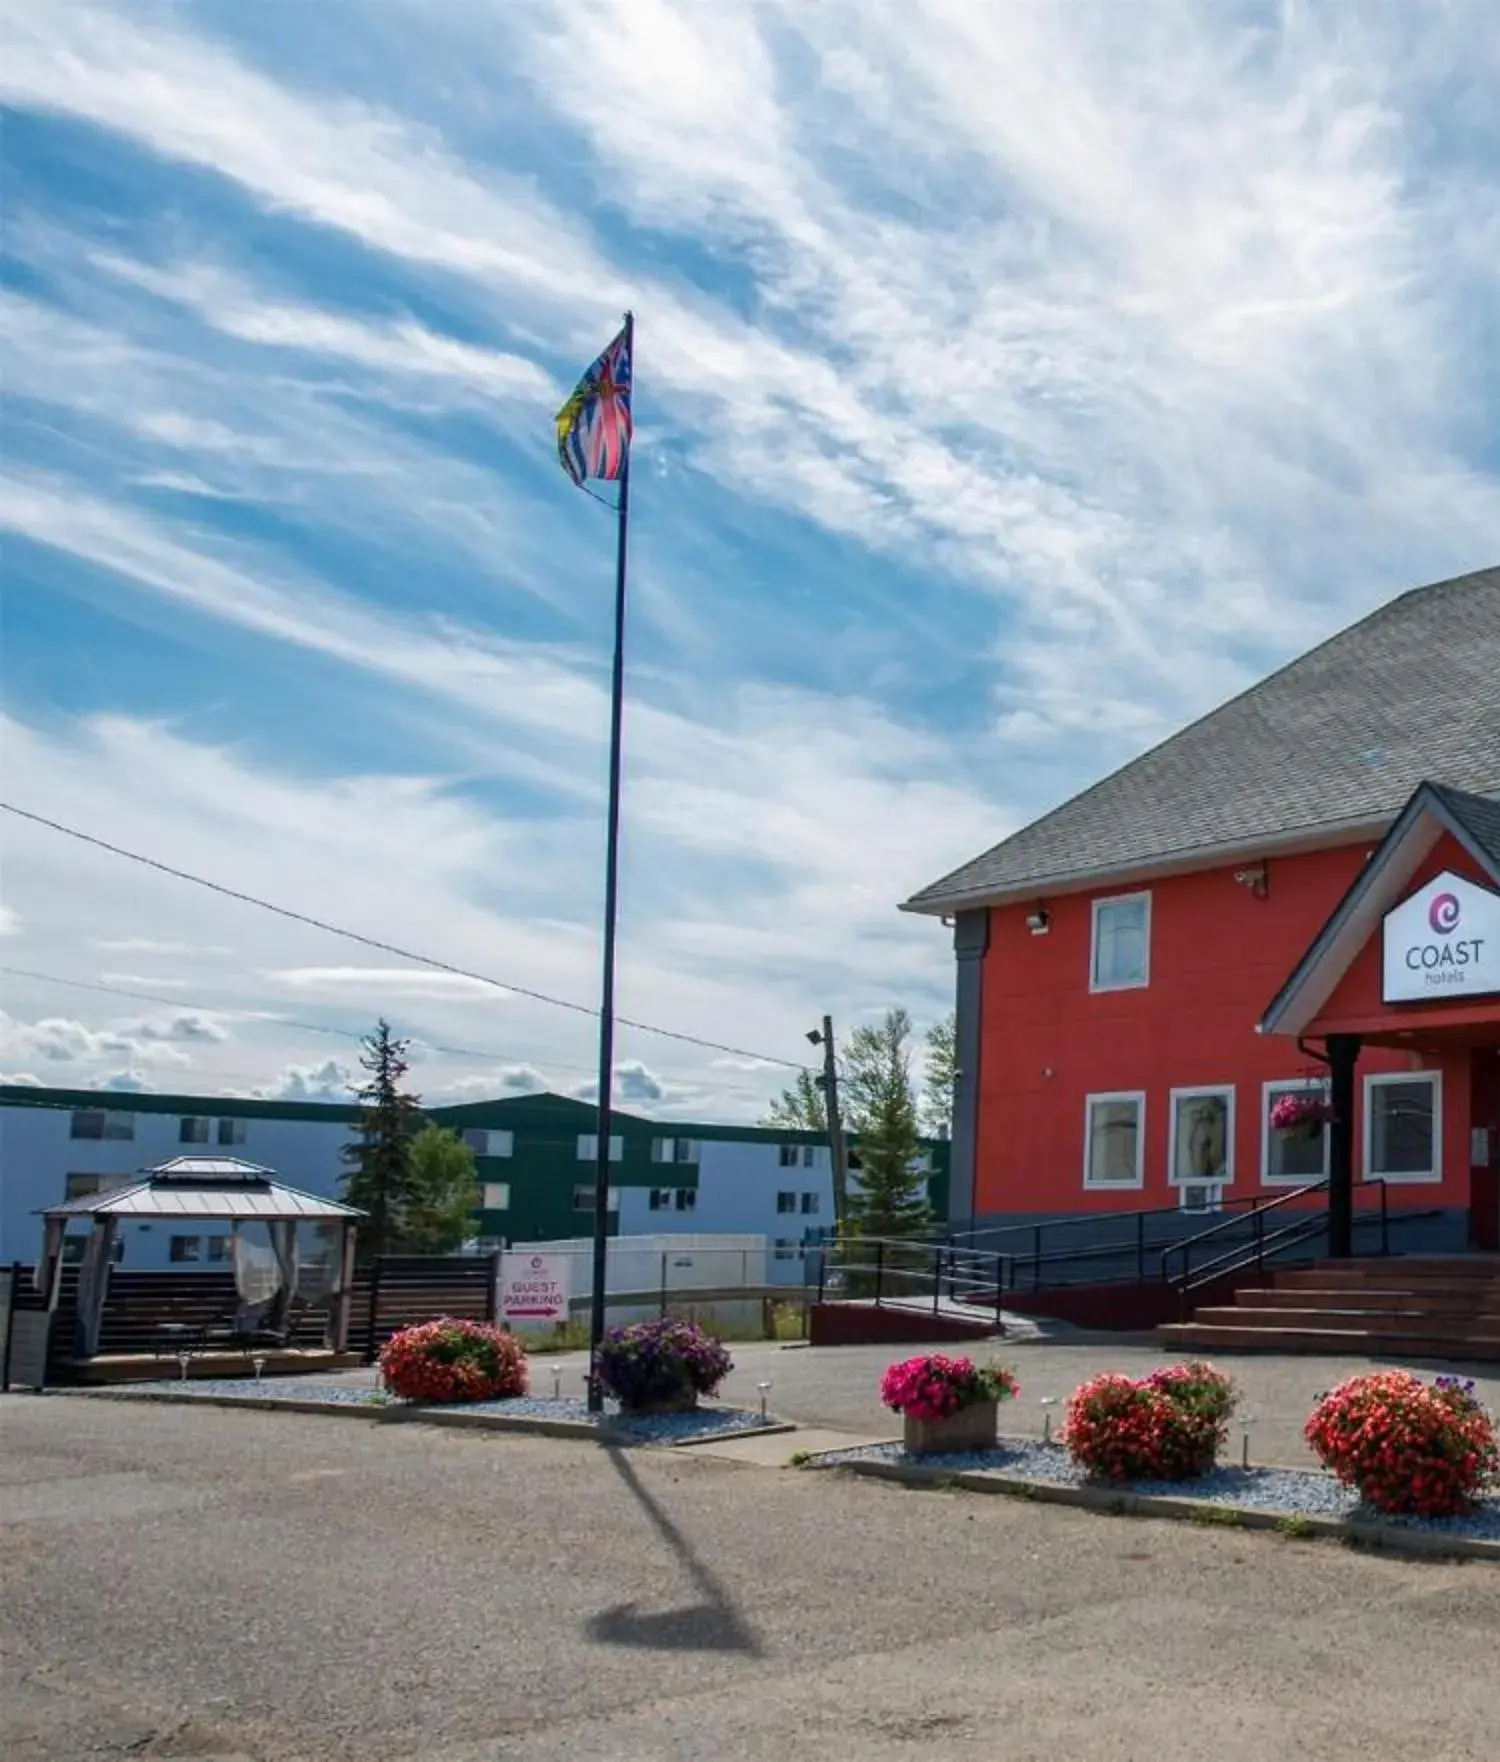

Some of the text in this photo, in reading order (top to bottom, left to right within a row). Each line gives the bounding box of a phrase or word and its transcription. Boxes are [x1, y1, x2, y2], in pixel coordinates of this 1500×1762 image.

[1406, 940, 1484, 969] COAST
[1425, 970, 1465, 985] hotels
[512, 1281, 557, 1293] GUEST
[503, 1294, 563, 1305] PARKING
